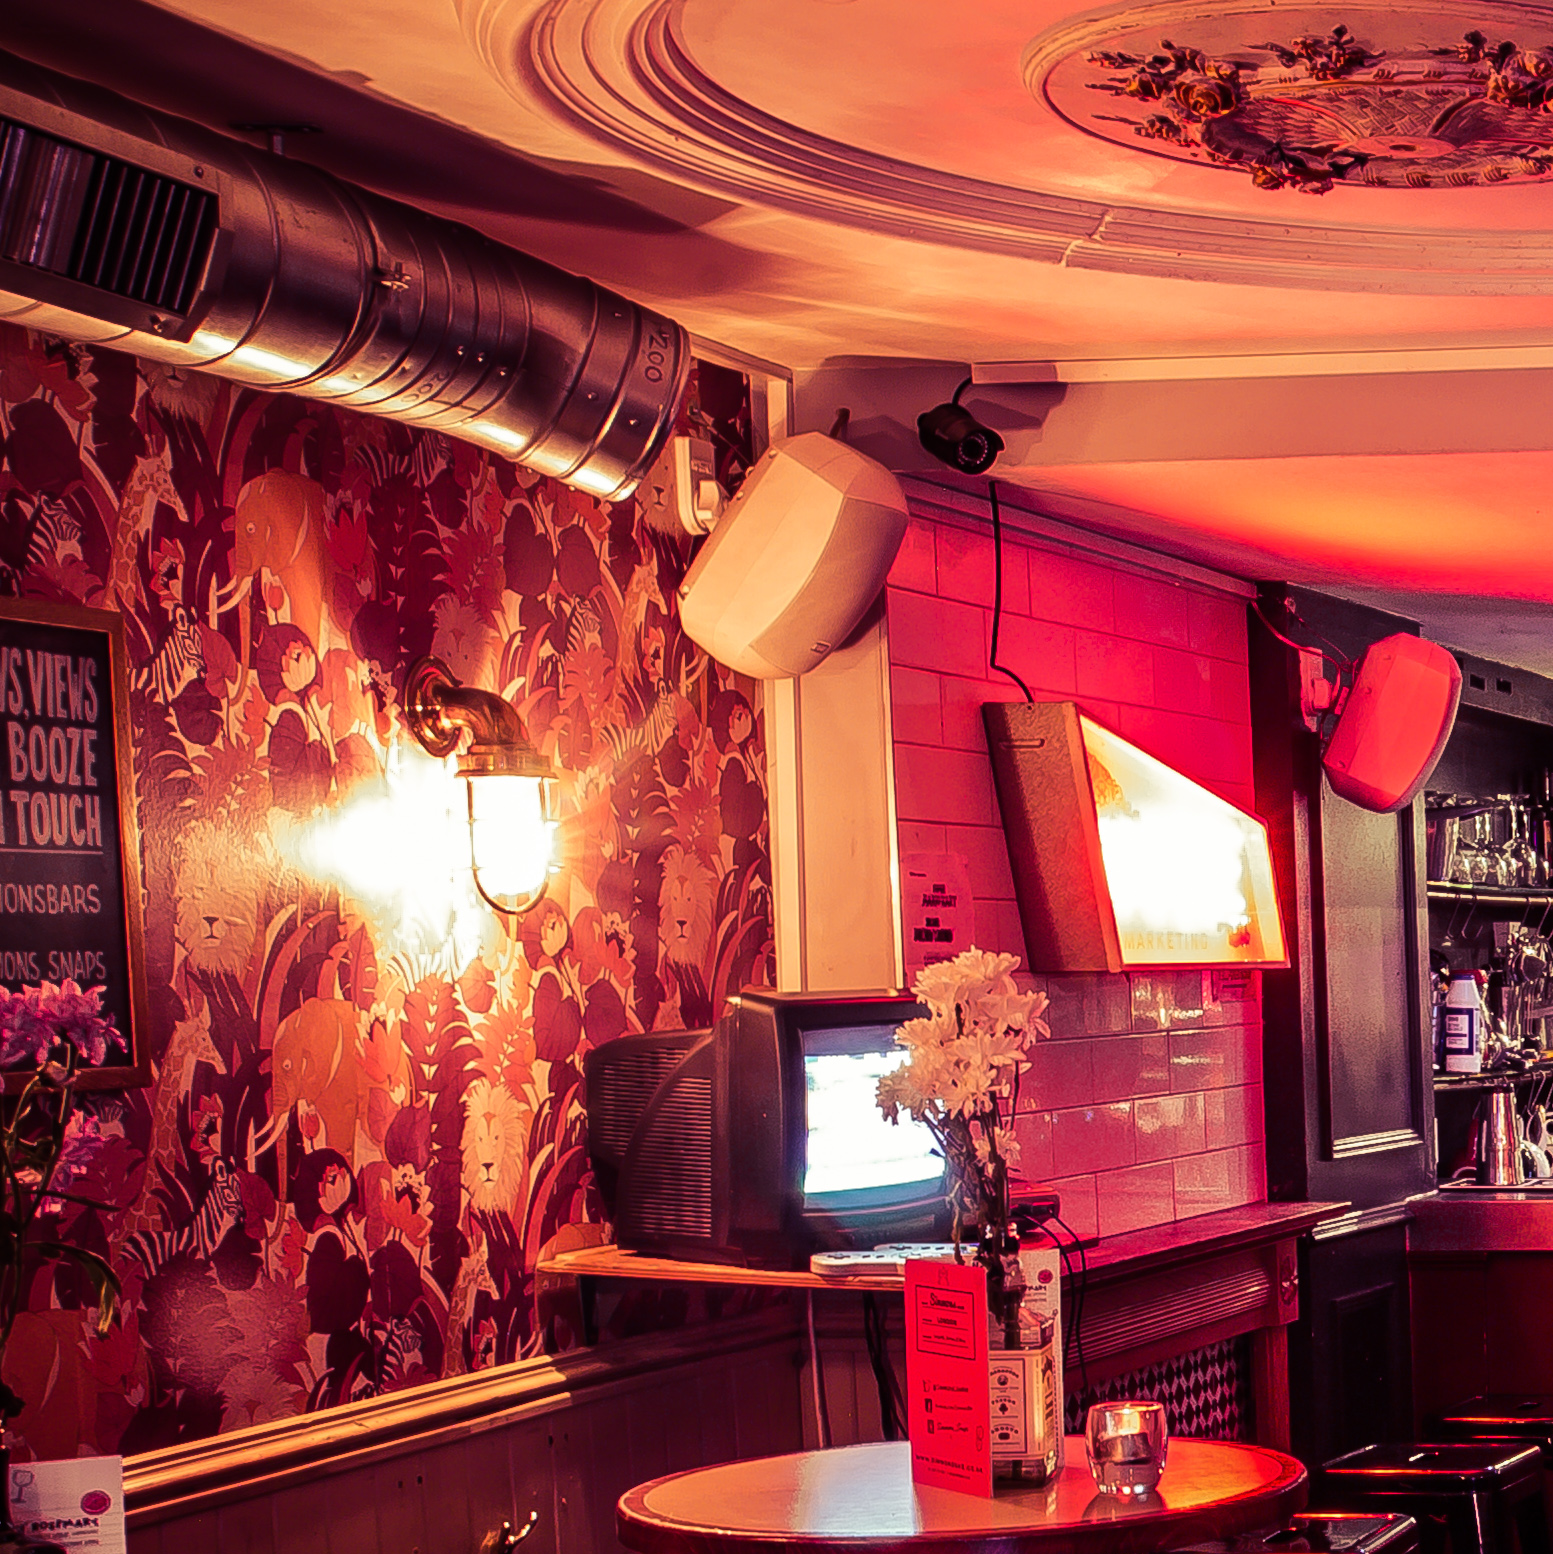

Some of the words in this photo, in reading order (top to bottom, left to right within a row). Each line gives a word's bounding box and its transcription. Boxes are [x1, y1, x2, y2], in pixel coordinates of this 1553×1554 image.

[7, 721, 97, 786] BOOZE
[10, 791, 102, 846] TOUCH
[0, 883, 100, 915] ONSBARS
[0, 951, 40, 981] ONS
[49, 951, 106, 980] SNAPS
